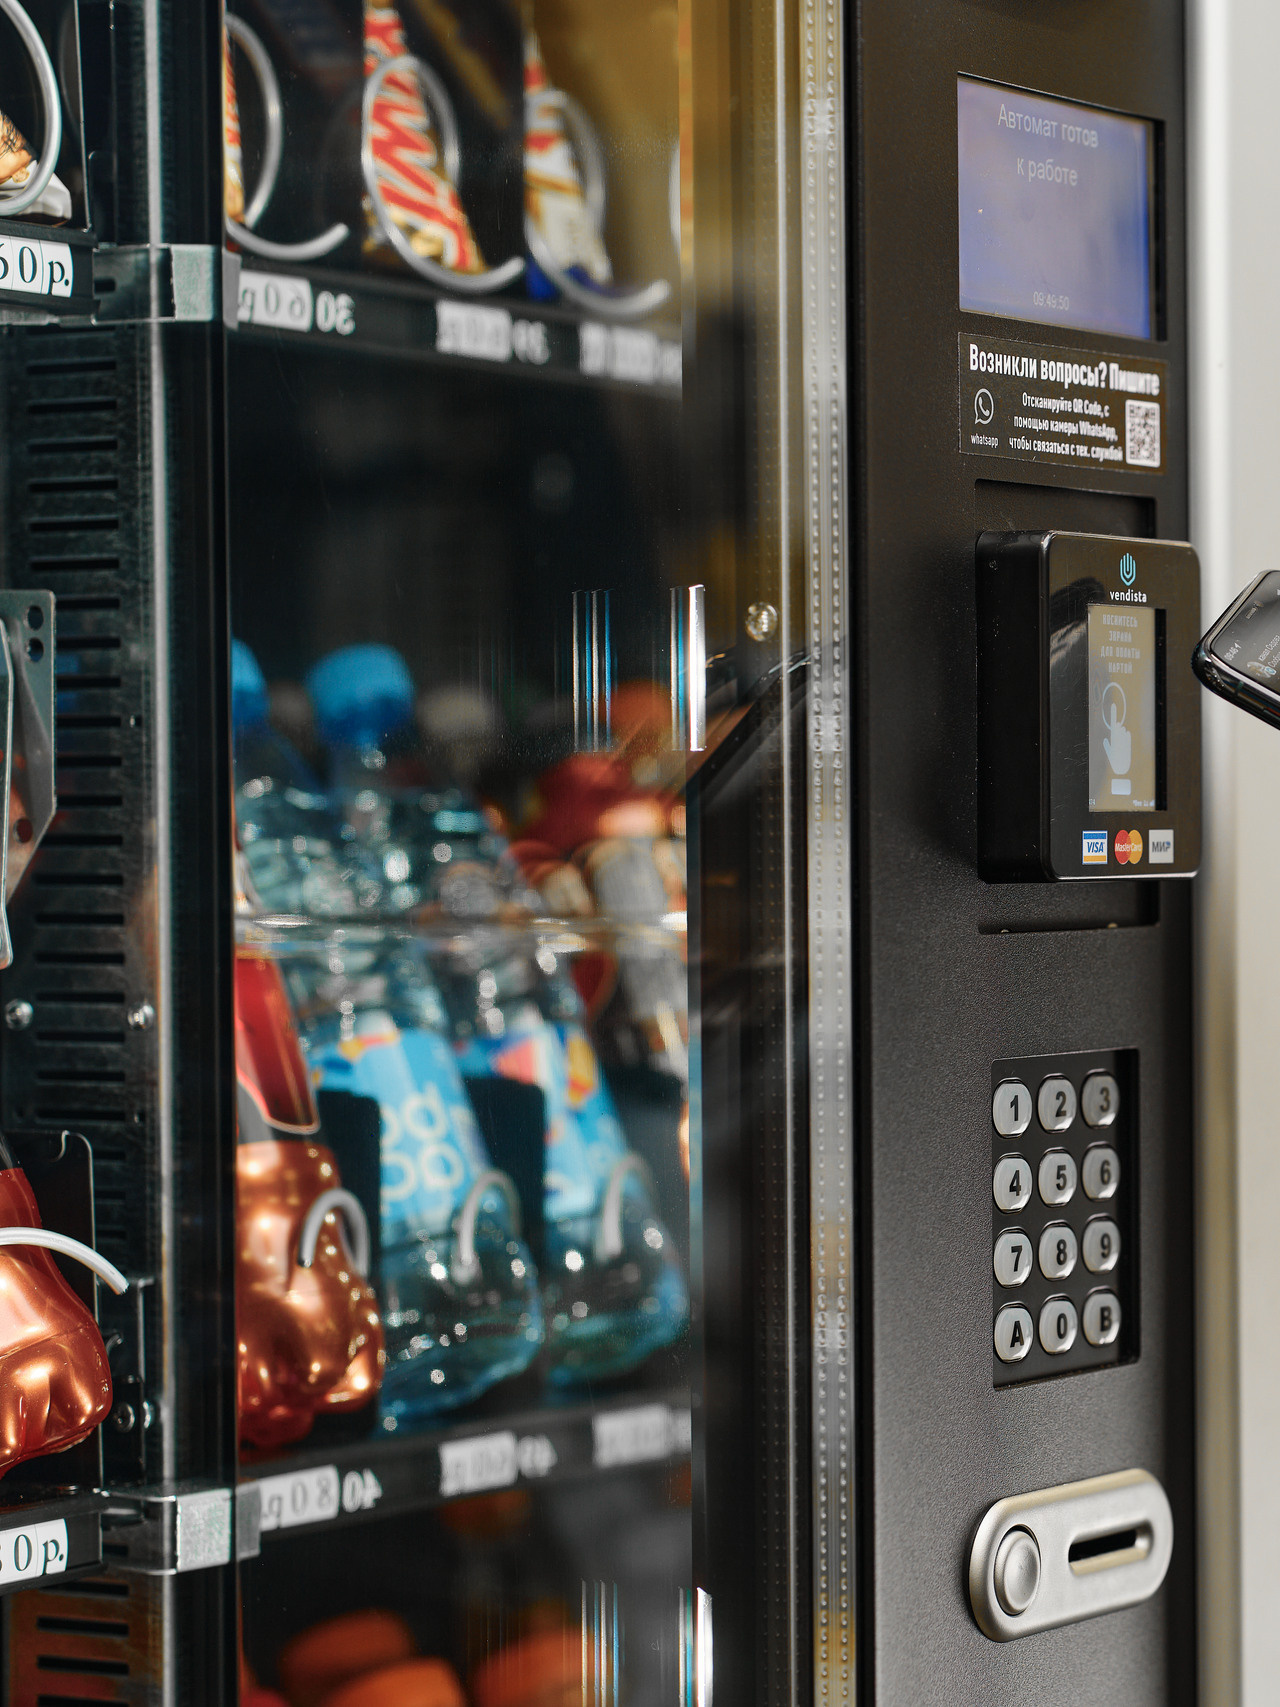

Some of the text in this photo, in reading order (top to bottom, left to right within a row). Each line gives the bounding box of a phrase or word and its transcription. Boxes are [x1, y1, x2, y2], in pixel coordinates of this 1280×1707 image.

[998, 103, 1099, 148] Автомат готов
[1017, 157, 1078, 186] к работе
[1033, 291, 1070, 312] 09:49:50
[969, 343, 1160, 396] Возникли вопросы? Пишите
[1022, 392, 1072, 413] Отсканируйте
[1072, 398, 1084, 414] QR
[1014, 416, 1049, 432] помощью
[1050, 420, 1079, 436] камеры
[970, 433, 999, 449] whatsapp
[1009, 436, 1032, 451] чтобы
[1032, 440, 1070, 455] связаться
[1110, 588, 1148, 603] vendista
[1102, 614, 1138, 628] КОСНИТЕСЬ
[1108, 630, 1132, 643] ЭКРАНА
[1100, 645, 1140, 659] ДЛЯ ОПЛАТЫ
[1108, 662, 1132, 674] КАРТОЙ
[1086, 842, 1104, 853] VISA
[1115, 842, 1142, 852] MasterCard
[1009, 1095, 1019, 1122] 1
[1056, 1091, 1067, 1117] 2
[1100, 1087, 1110, 1113] 3
[1009, 1170, 1021, 1196] 4
[1056, 1165, 1067, 1191] 5
[1100, 1160, 1111, 1186] 6
[1011, 1246, 1022, 1272] 7
[1056, 1239, 1067, 1266] 8
[1100, 1233, 1111, 1259] 9
[1057, 1313, 1067, 1339] 0
[1100, 1306, 1112, 1332] B
[1010, 1321, 1024, 1348] A
[0, 1534, 64, 1575] 0р.
